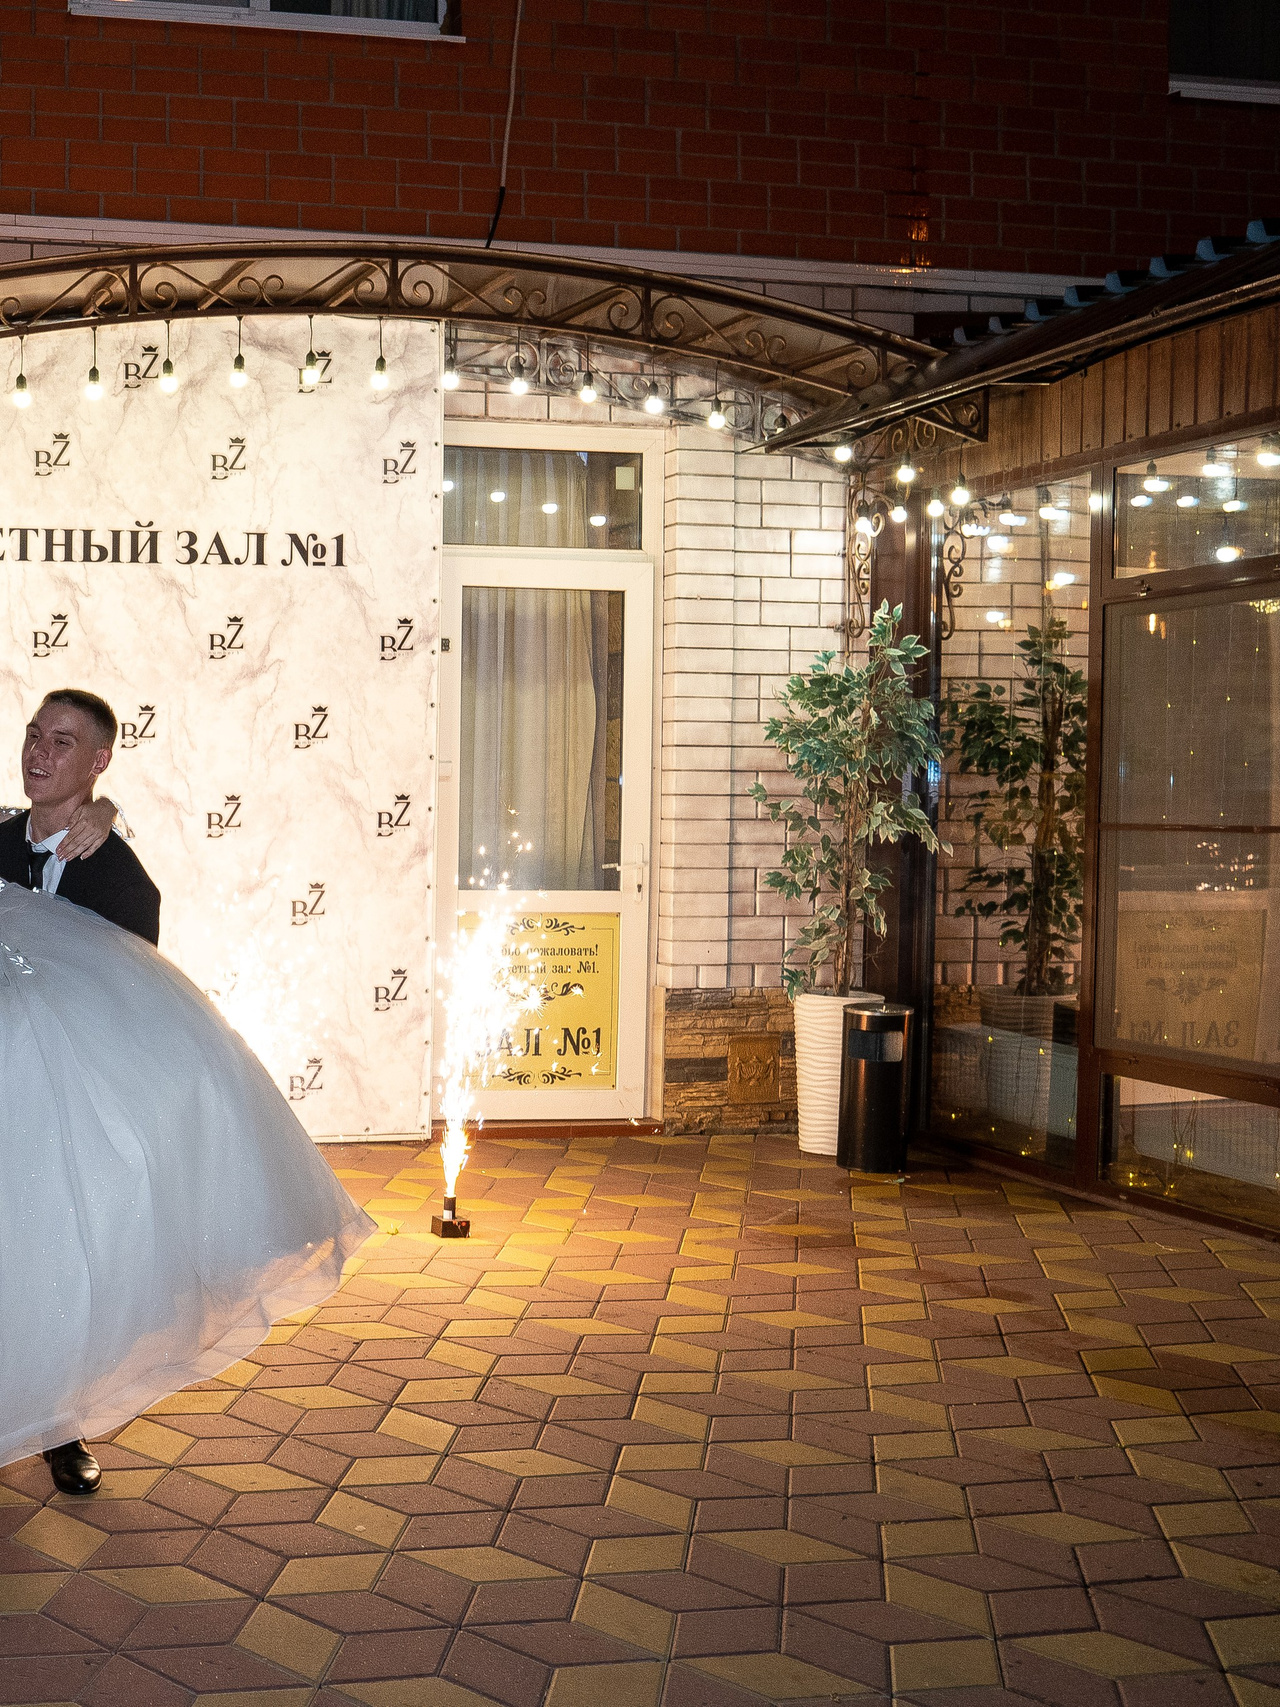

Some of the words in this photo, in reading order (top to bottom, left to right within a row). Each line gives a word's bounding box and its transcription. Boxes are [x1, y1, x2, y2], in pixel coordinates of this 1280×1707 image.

[176, 530, 268, 566] ЗАЛ
[281, 533, 347, 567] №1
[557, 1026, 602, 1057] №1
